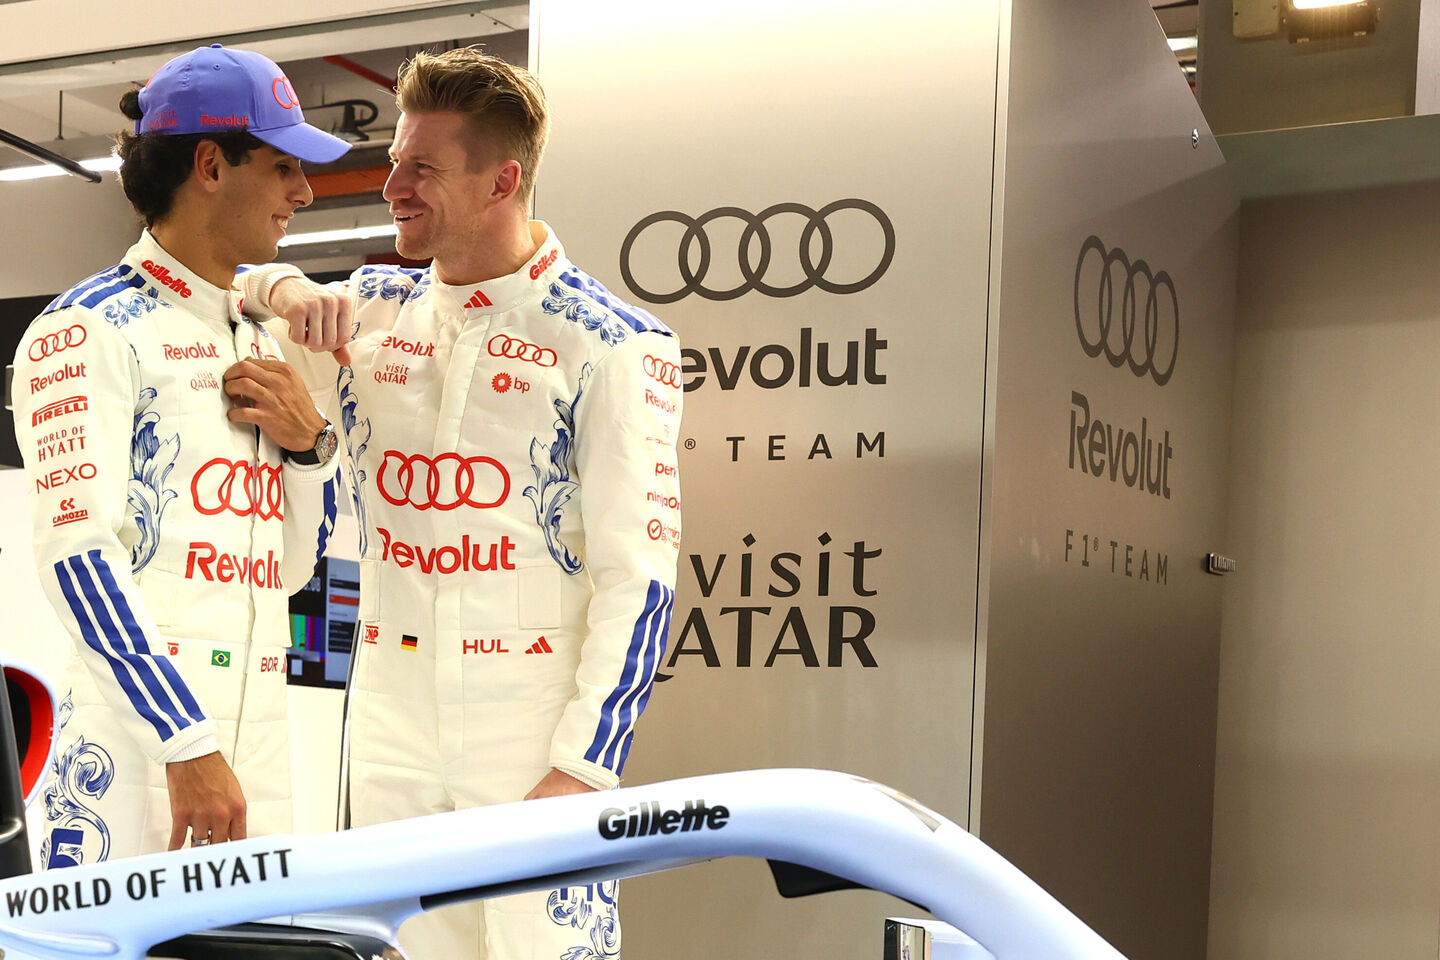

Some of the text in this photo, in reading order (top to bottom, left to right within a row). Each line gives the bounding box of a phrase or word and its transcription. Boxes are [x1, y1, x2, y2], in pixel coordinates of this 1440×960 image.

[200, 113, 249, 127] Revolut
[141, 259, 192, 299] Gillette
[162, 341, 220, 361] Revolut
[381, 336, 436, 358] evolut
[681, 327, 888, 393] evolut
[30, 362, 87, 396] Revolut
[374, 370, 408, 386] QATAR
[385, 362, 410, 376] visit
[190, 378, 220, 392] QATAR
[513, 377, 531, 394] bp
[32, 395, 89, 428] PIRELLI
[37, 425, 86, 447] WORLD OF
[38, 436, 87, 463] HYATT
[726, 431, 886, 462] TEAM
[1068, 390, 1173, 500] Revolut
[36, 463, 98, 495] NEXO
[52, 509, 89, 524] CAMOZZI
[185, 541, 283, 591] Revol
[689, 532, 882, 598] visit
[1110, 540, 1169, 586] TEAM
[462, 639, 510, 655] HUL
[654, 606, 879, 683] ATAR
[260, 656, 279, 673] BOR
[598, 799, 730, 841] Gillette
[6, 849, 293, 919] WORLD OF HYATT
